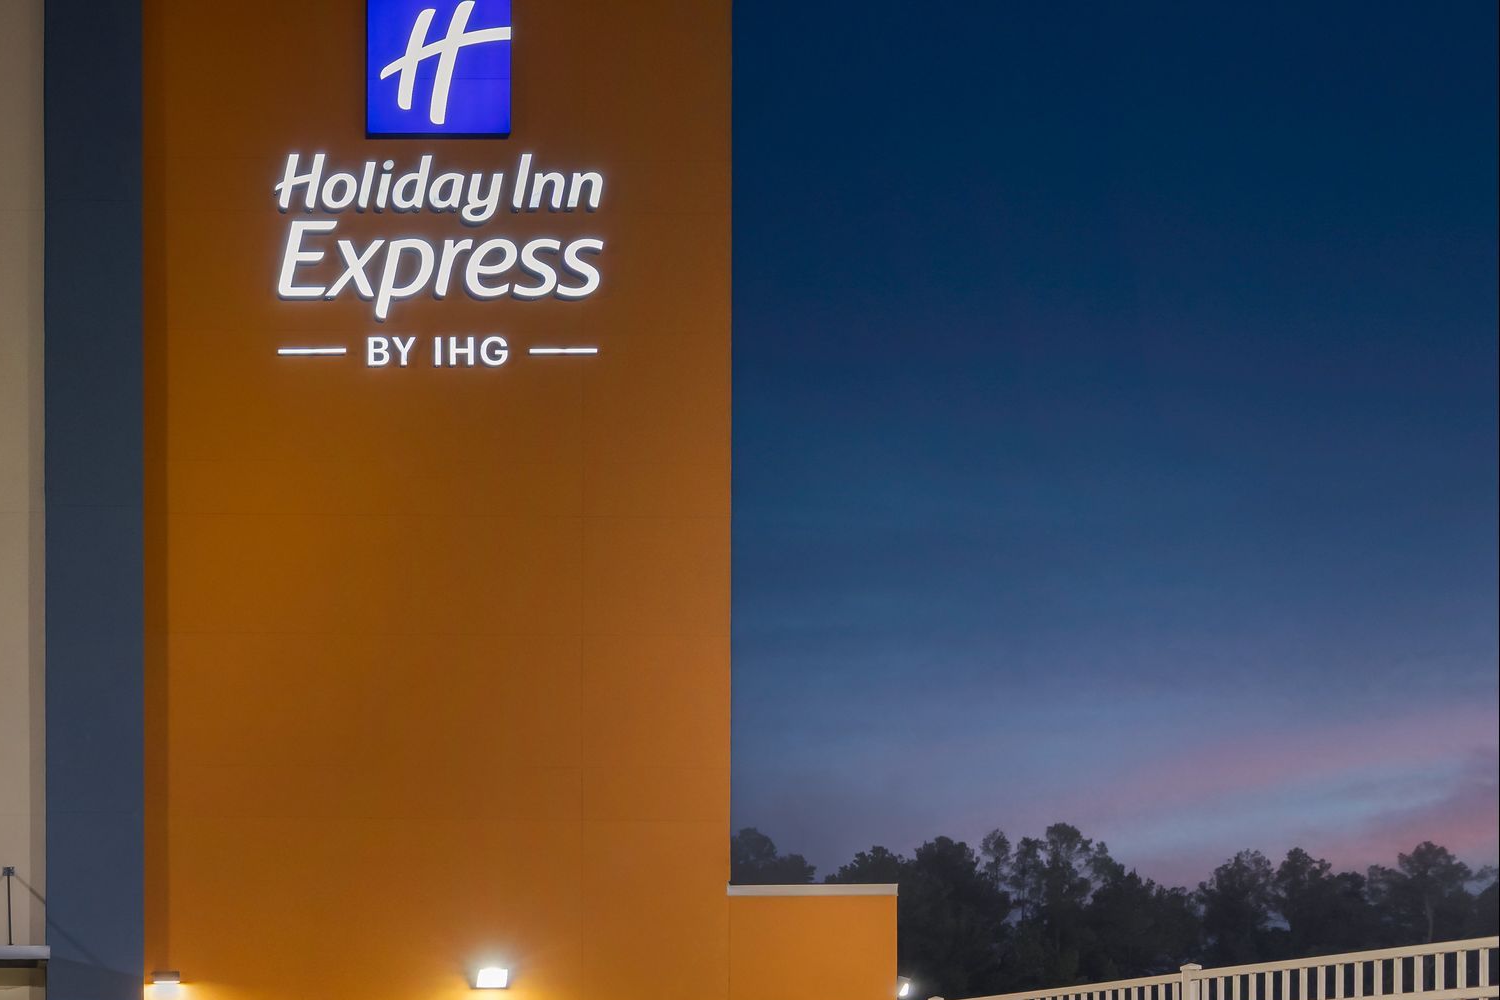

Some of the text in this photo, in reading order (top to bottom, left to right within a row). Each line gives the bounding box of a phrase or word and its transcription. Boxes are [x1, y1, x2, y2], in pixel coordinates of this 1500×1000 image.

[274, 153, 604, 223] Holiday Inn
[277, 220, 604, 320] Express
[367, 336, 509, 366] BY IHG
